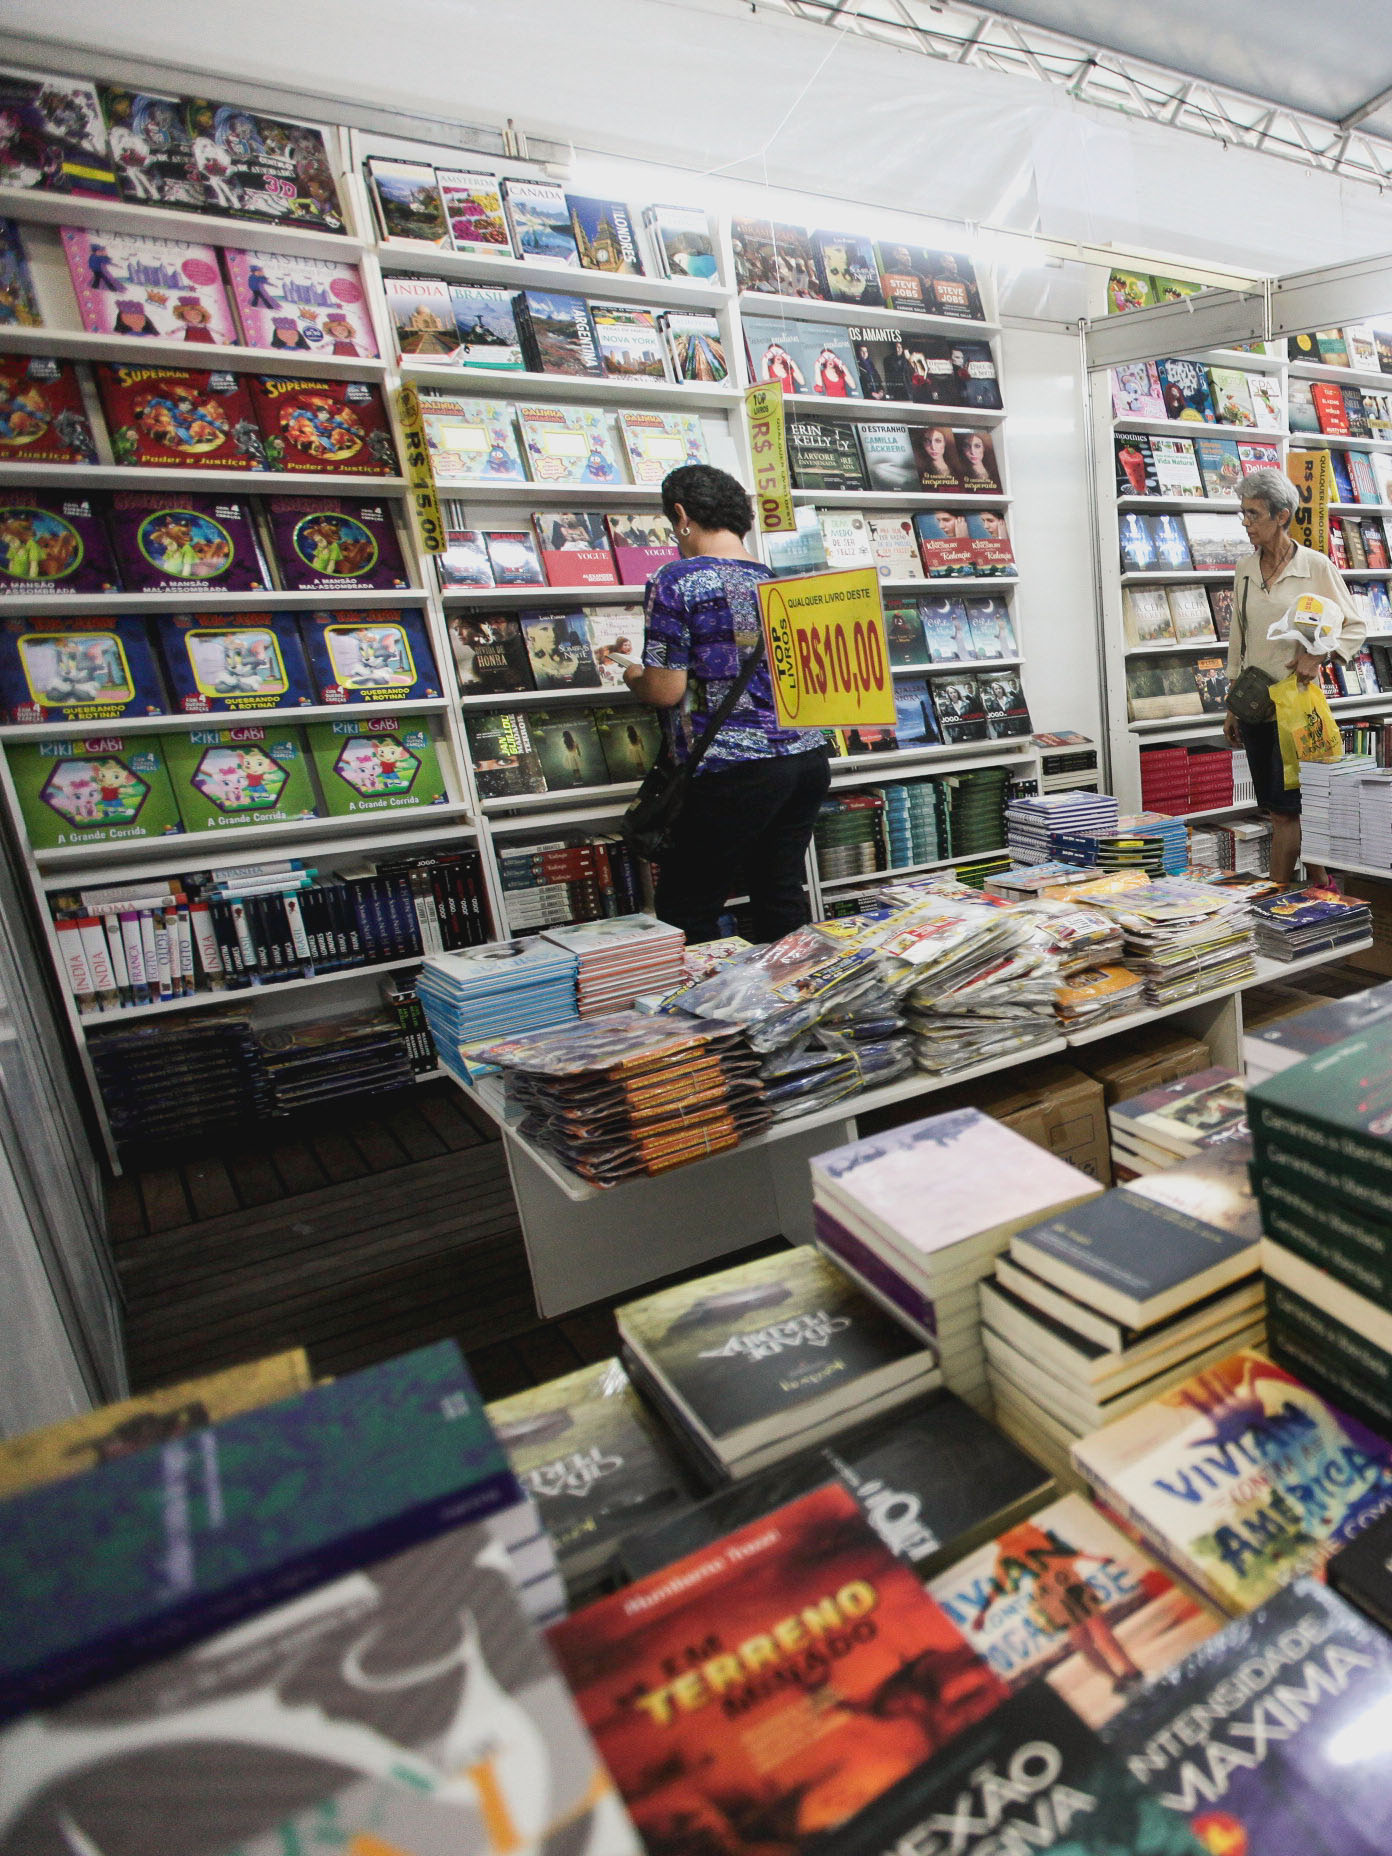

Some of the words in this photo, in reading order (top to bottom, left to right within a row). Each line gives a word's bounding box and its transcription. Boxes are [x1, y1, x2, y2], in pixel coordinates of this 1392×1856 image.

[263, 175, 297, 199] 3D
[612, 206, 636, 263] LONDRES
[890, 280, 919, 289] STEVE
[937, 287, 964, 295] STEVE
[894, 289, 919, 298] JOBS
[941, 294, 964, 304] JOBS
[572, 298, 599, 369] ARGENTINA
[603, 335, 624, 344] NOVA
[630, 336, 656, 345] YORK
[850, 327, 861, 341] OS
[862, 328, 902, 342] AMANTES
[118, 368, 189, 387] SUPERMAN
[265, 381, 329, 398] SUPERMAN
[754, 393, 766, 406] TOP
[521, 408, 564, 417] GALINHA
[624, 414, 663, 422] GALINHA
[752, 422, 773, 453] R$
[791, 424, 821, 436] ERIN
[794, 435, 831, 447] KELLY
[141, 455, 182, 466] Poder
[186, 457, 194, 465] e
[199, 457, 247, 467] Justiça
[287, 462, 323, 471] Poder
[337, 464, 381, 473] Justiça
[1304, 460, 1313, 482] R$
[1318, 455, 1326, 503] QUALQUER
[757, 463, 781, 528] 15,00
[413, 479, 440, 551] 15,00
[577, 552, 608, 560] VOGUE
[788, 594, 824, 608] QUALQUER
[825, 591, 845, 604] LIVRO
[847, 588, 870, 601] DESTE
[1185, 601, 1205, 610] CEIA
[477, 653, 508, 667] HONRA
[772, 626, 786, 681] TOP
[780, 618, 796, 689] LIVROS
[225, 695, 281, 706] QUEBRANDO
[360, 688, 410, 699] QUEBRANDO
[372, 692, 406, 701] ROTINA!
[63, 704, 126, 715] QUEBRANDO
[238, 700, 276, 710] ROTINA!
[78, 710, 119, 720] ROTINA!
[500, 736, 510, 756] JAN
[349, 801, 356, 809] A
[358, 798, 388, 808] Grande
[391, 795, 419, 807] Corrida
[207, 817, 215, 826] A
[217, 813, 251, 824] Grande
[253, 809, 287, 822] Corrida
[58, 833, 66, 843] A
[68, 830, 105, 842] Grande
[108, 826, 147, 839] Corrida
[92, 902, 136, 915] ROMA
[308, 935, 318, 958] LONDRES
[317, 933, 327, 956] LONDRES
[326, 931, 336, 954] LONDRES
[181, 940, 192, 971] EGITO
[1152, 1400, 1319, 1504] VIVIAN
[634, 1579, 877, 1726] TERRENO
[1126, 1609, 1332, 1785] NTENSIDADE
